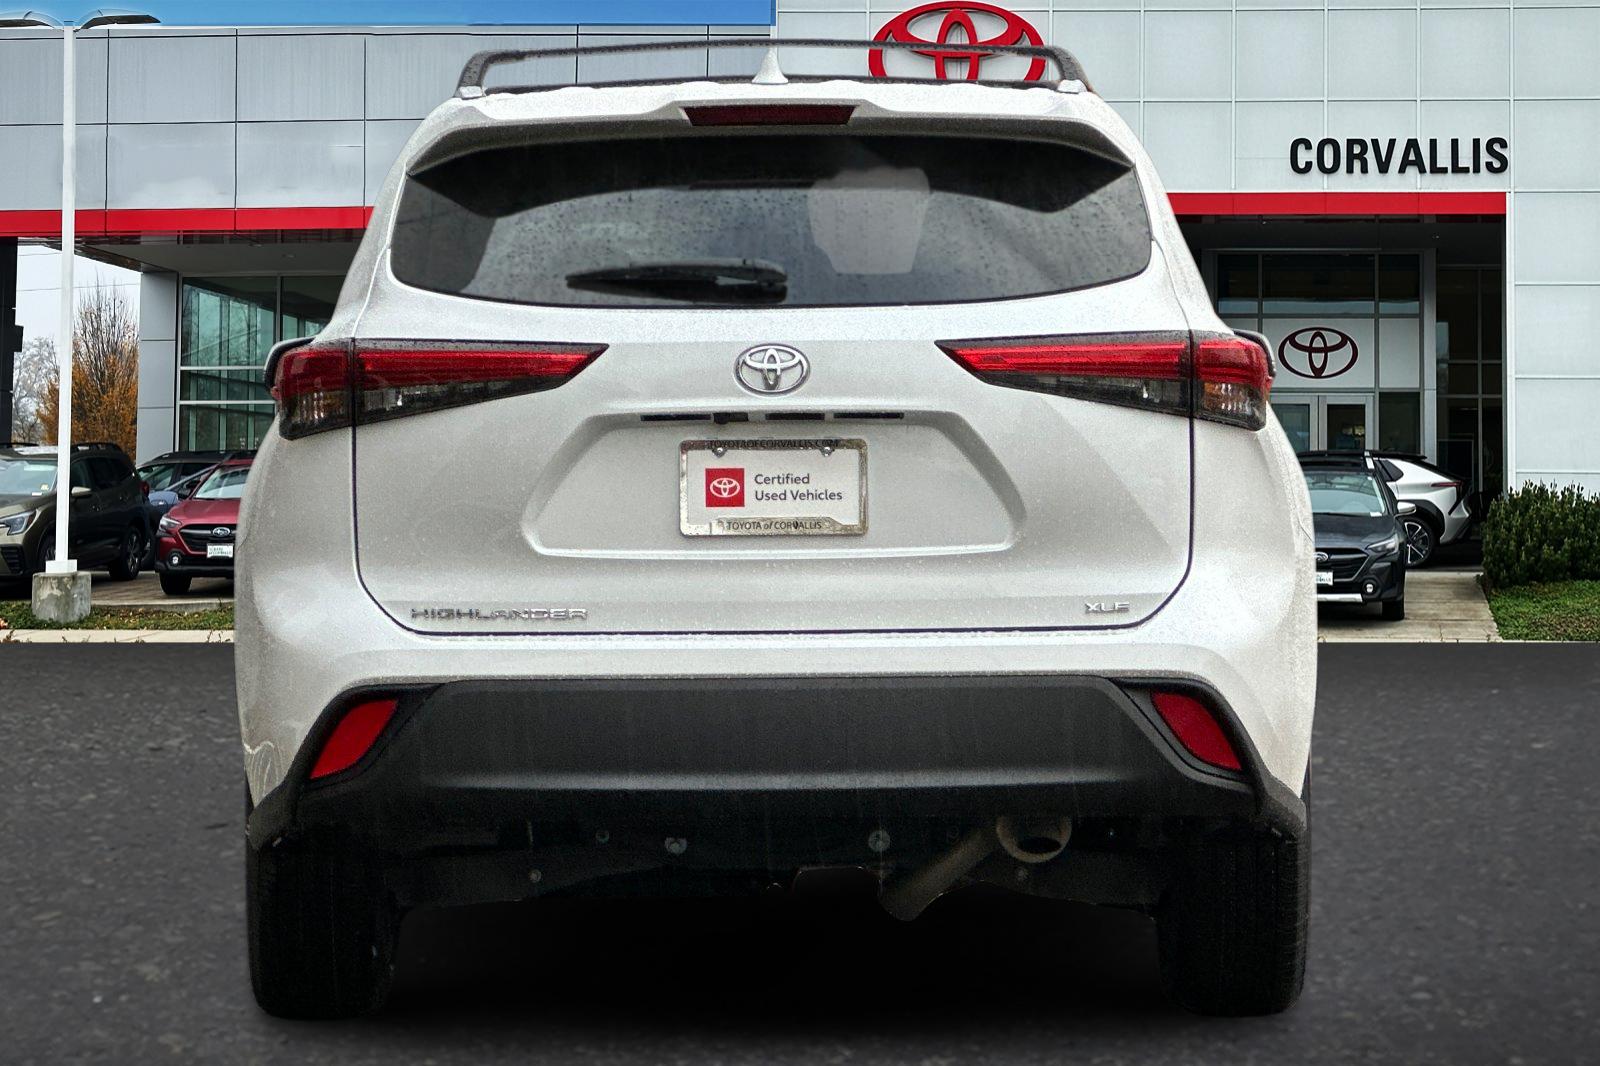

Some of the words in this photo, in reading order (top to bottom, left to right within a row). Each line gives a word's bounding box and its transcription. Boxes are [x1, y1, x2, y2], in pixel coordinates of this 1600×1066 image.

[1290, 137, 1508, 174] CORVALLIS
[754, 473, 810, 485] Certified
[755, 489, 787, 501] Used
[790, 489, 843, 501] Vehicles
[726, 521, 761, 531] TOYOTA
[764, 520, 774, 530] of
[776, 520, 822, 531] CORVALLIS
[1084, 601, 1130, 613] XLE
[411, 607, 588, 620] HIGHLANDER
